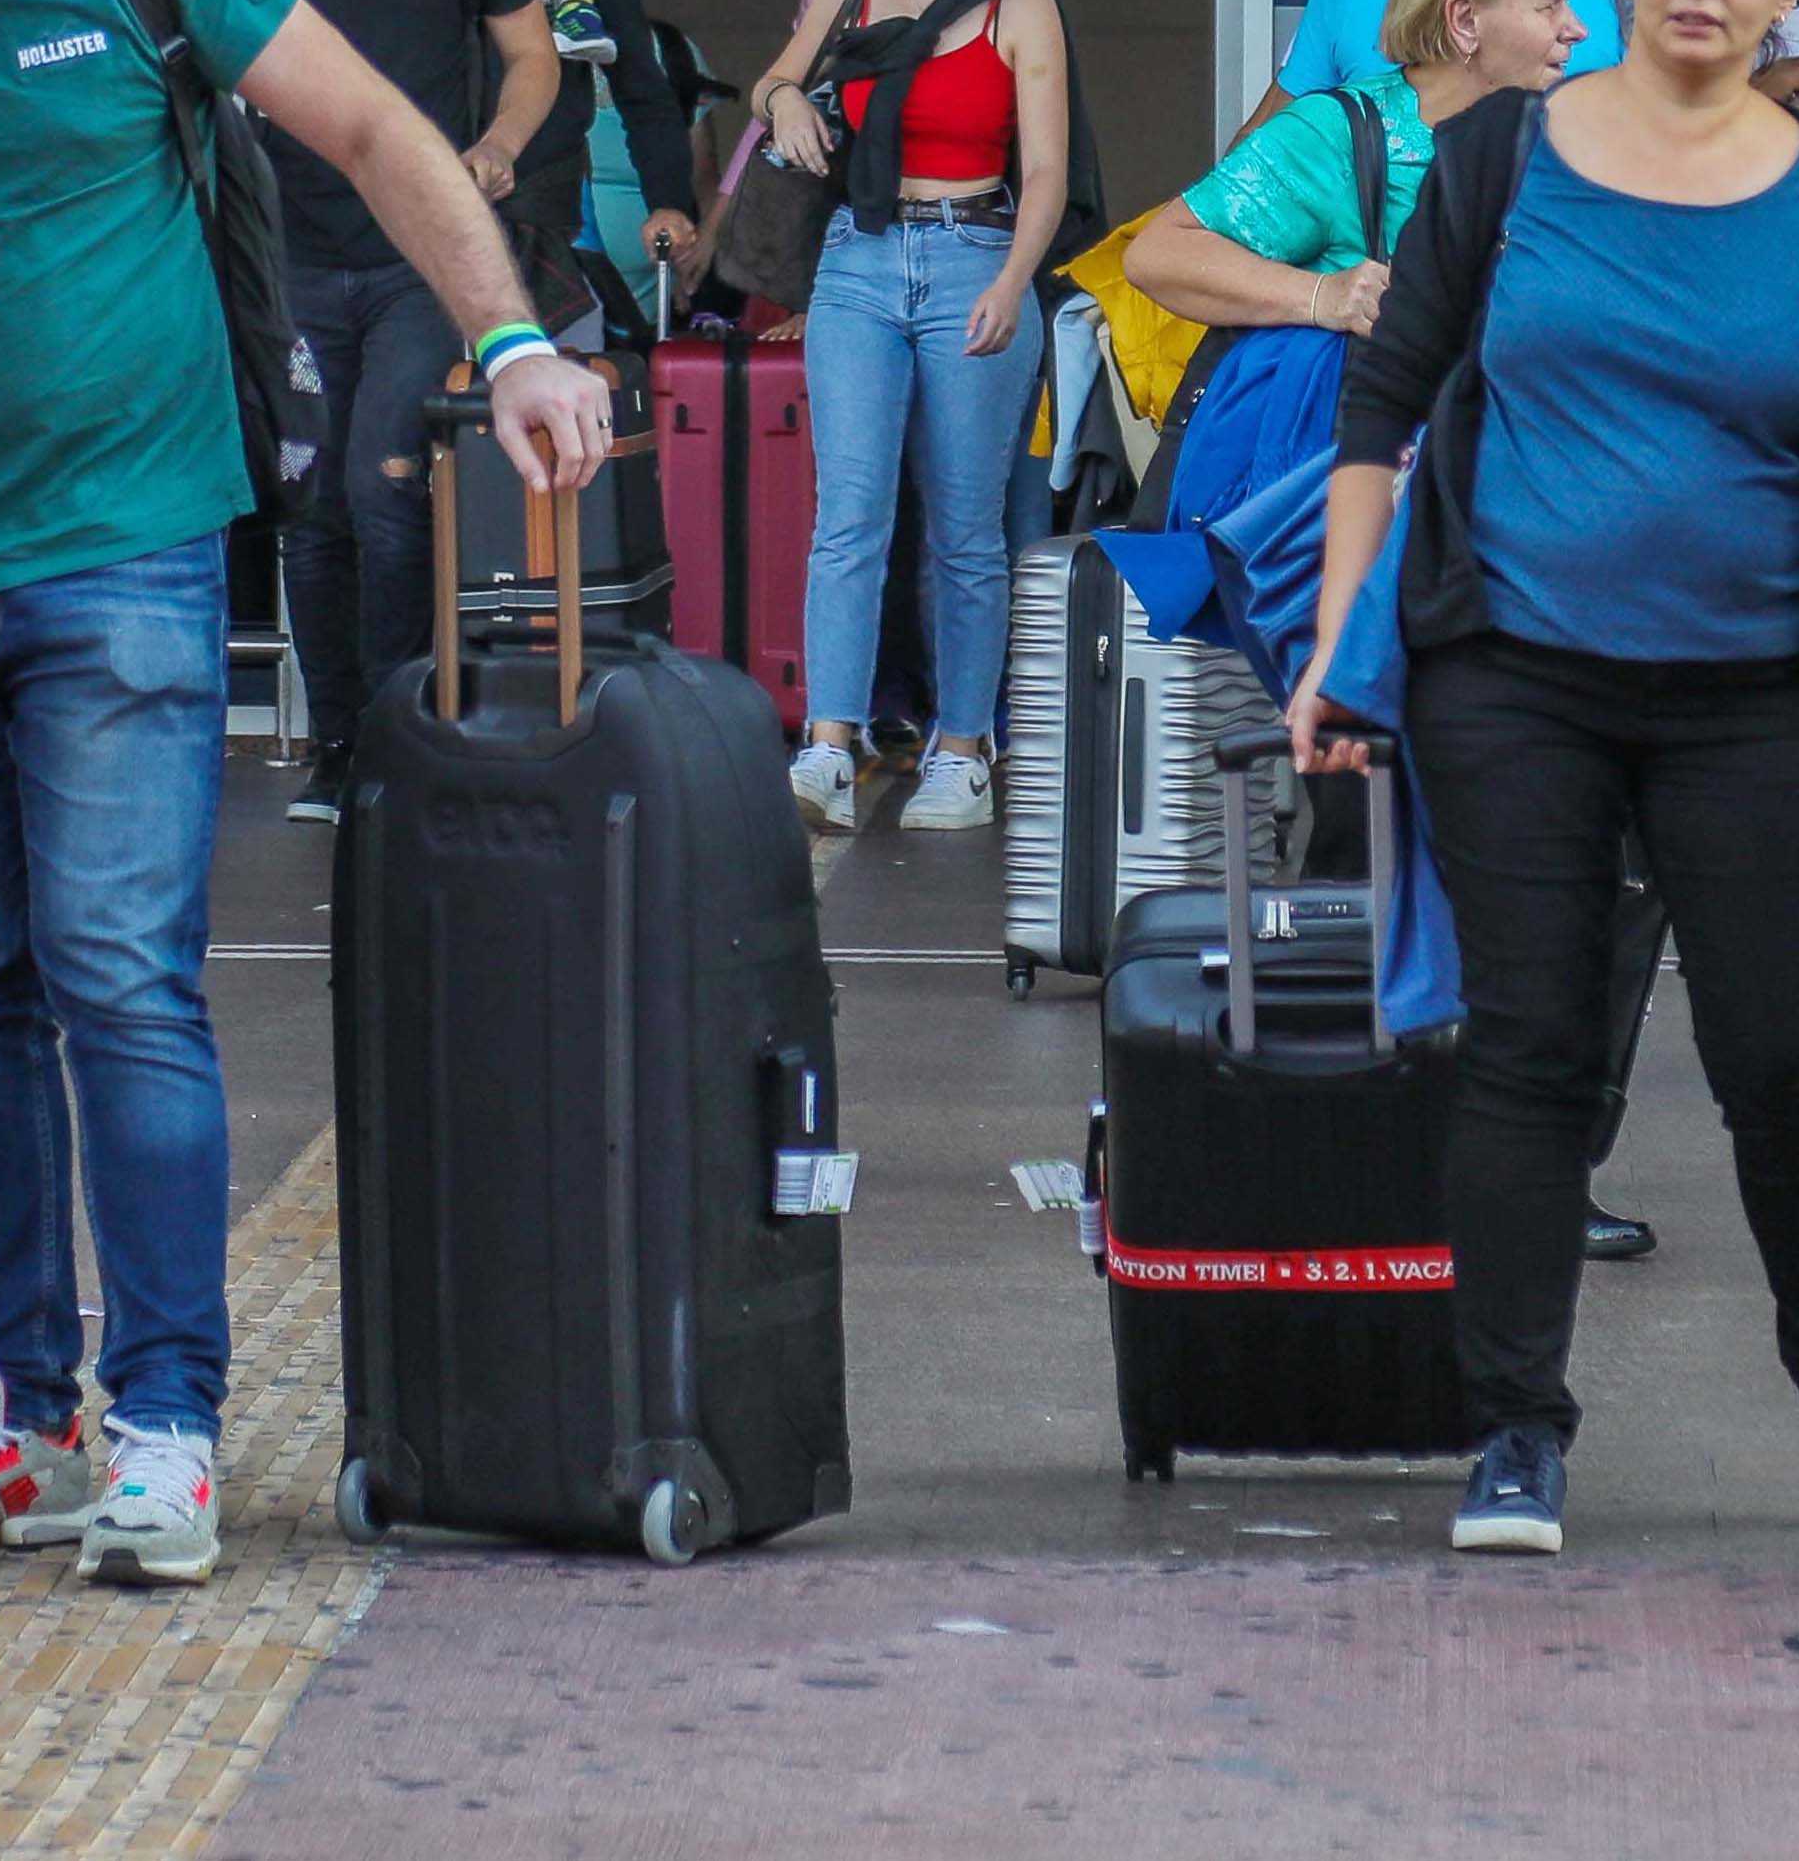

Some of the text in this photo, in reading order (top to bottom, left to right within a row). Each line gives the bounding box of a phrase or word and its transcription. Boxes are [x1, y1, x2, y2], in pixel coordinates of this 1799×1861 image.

[17, 31, 108, 70] HOLLISTER
[1108, 1252, 1187, 1281] ATION
[1194, 1262, 1266, 1282] TIME!
[1387, 1260, 1454, 1280] VACA
